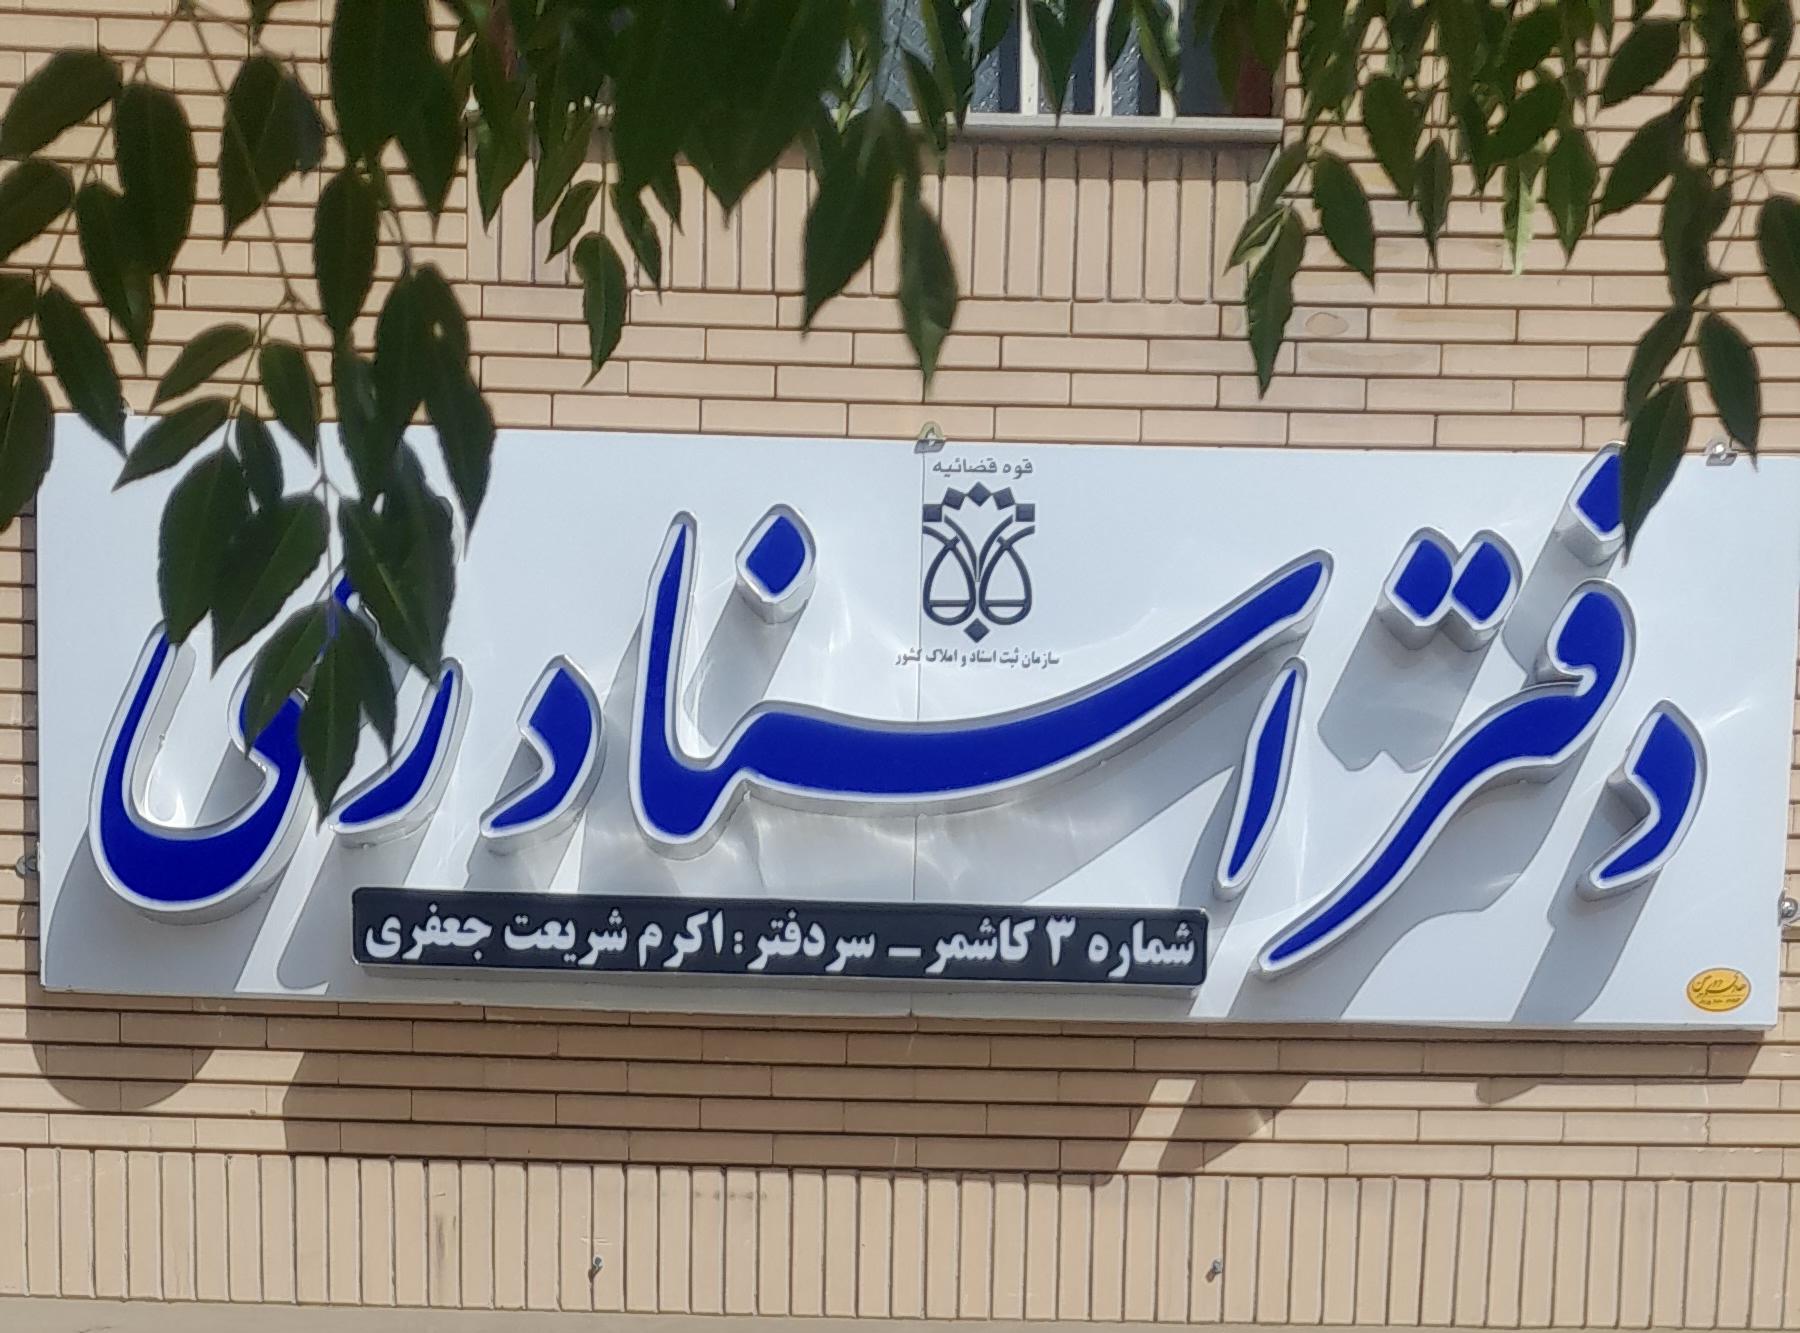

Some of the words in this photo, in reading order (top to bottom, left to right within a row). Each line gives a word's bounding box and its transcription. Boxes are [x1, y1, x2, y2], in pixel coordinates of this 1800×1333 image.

[932, 458, 997, 477] قضائیه
[1002, 459, 1033, 479] قوه
[895, 647, 922, 666] کشور
[925, 649, 958, 663] املاک
[960, 654, 967, 667] و
[969, 650, 996, 663] اسناد
[999, 647, 1019, 669] ثبت
[1021, 651, 1060, 669] سازمان
[89, 490, 468, 922] ری
[480, 504, 1333, 899] اسناد
[1256, 442, 1706, 978] دفتر
[364, 903, 493, 960] جعفری
[504, 908, 628, 967] شریعت
[638, 909, 724, 968] اکرم
[925, 917, 1036, 974] کاشمر
[1045, 914, 1077, 967] ۳
[1087, 919, 1195, 978] شماره
